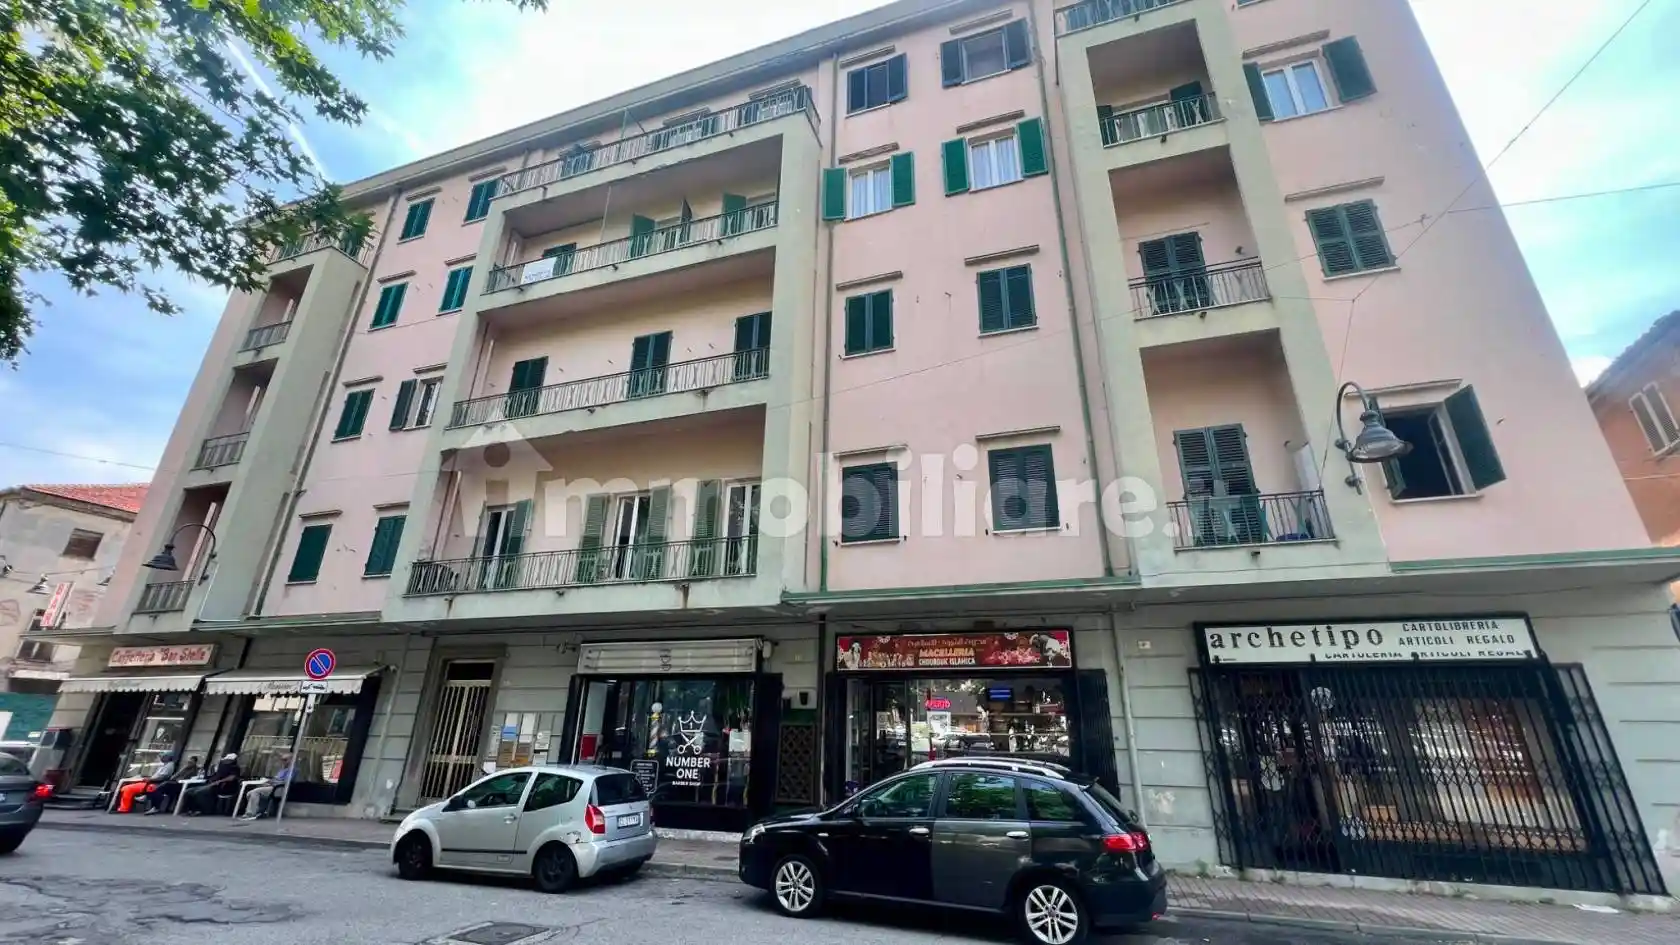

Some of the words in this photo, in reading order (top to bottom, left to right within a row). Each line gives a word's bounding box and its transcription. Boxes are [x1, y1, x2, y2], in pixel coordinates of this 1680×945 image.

[1402, 620, 1500, 632] CARTOLIBRERIA
[1209, 625, 1383, 650] archetipo
[1399, 635, 1454, 646] ARTICOLI
[1466, 634, 1515, 645] REGALO
[665, 756, 711, 768] NUMBER
[676, 768, 699, 779] ONE
